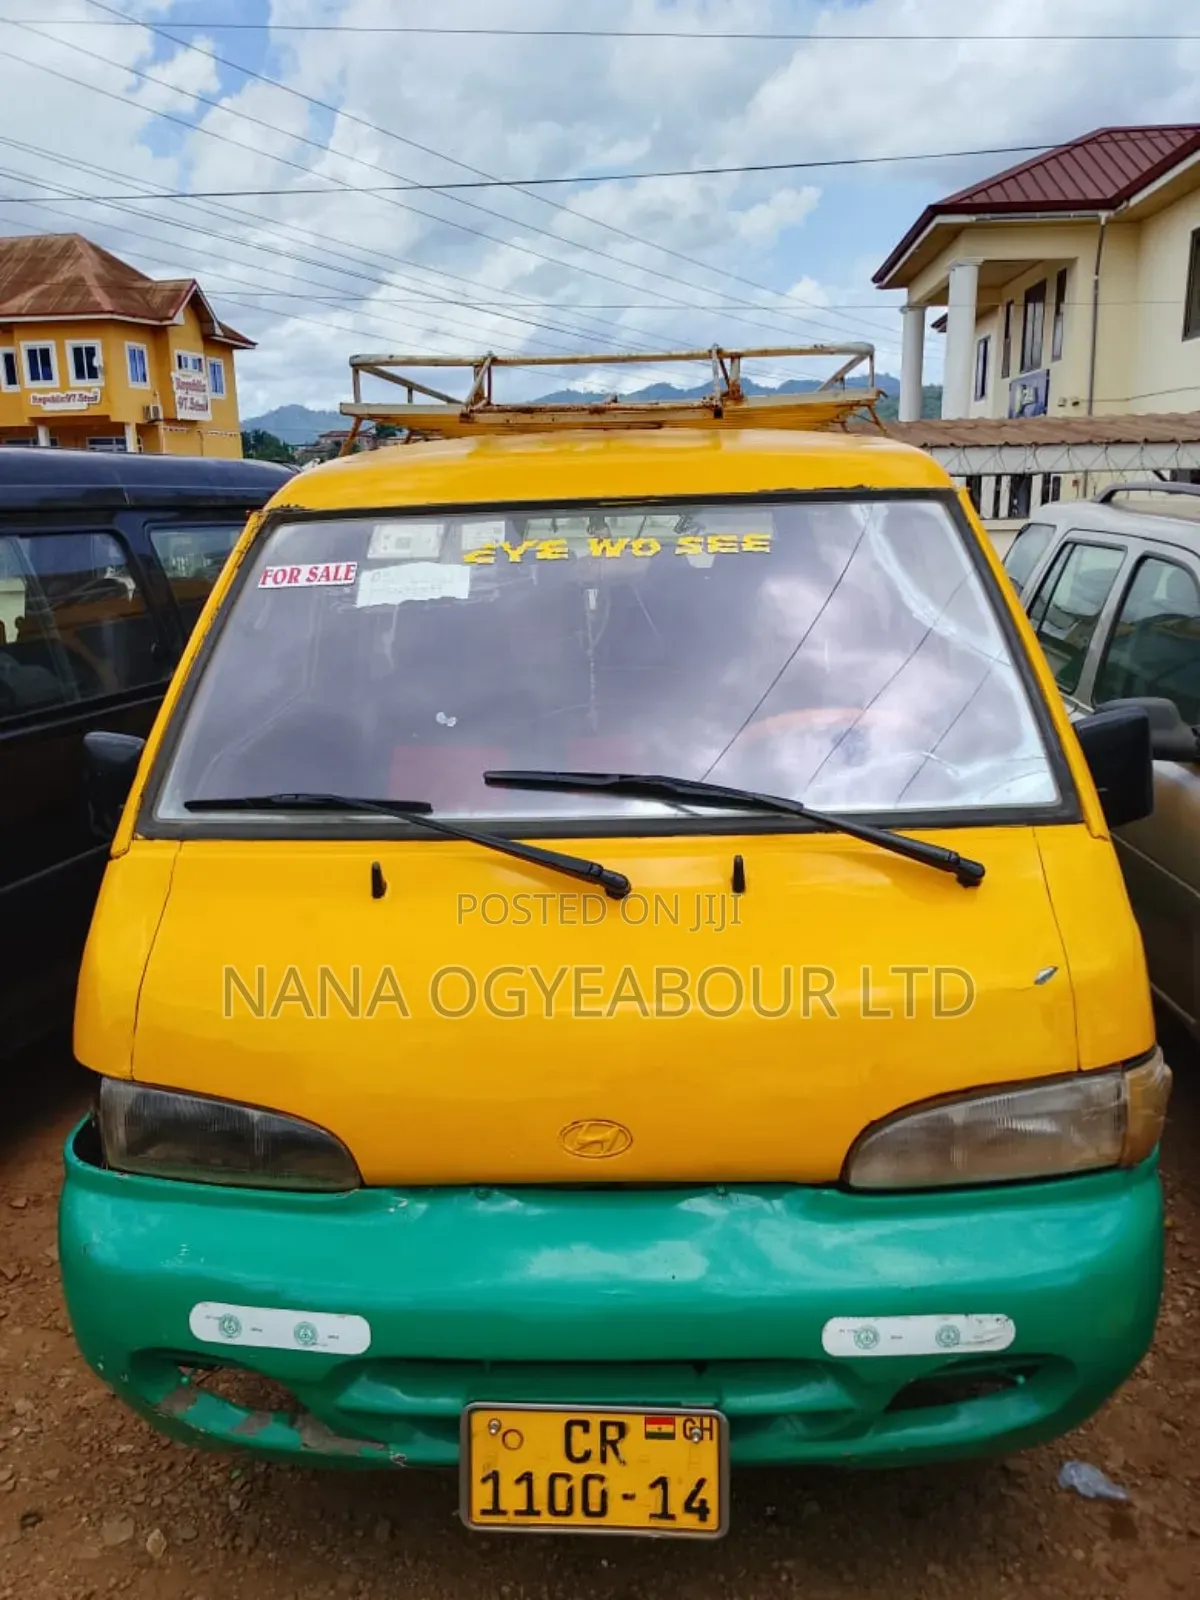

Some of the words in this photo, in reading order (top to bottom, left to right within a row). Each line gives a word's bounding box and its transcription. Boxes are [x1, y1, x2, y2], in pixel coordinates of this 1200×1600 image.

[588, 537, 660, 558] WO
[675, 534, 771, 555] SEE
[260, 567, 301, 585] FOR
[305, 564, 356, 583] SALE
[564, 1418, 628, 1466] CR
[682, 1417, 714, 1442] GH
[479, 1469, 711, 1523] 1100-14
